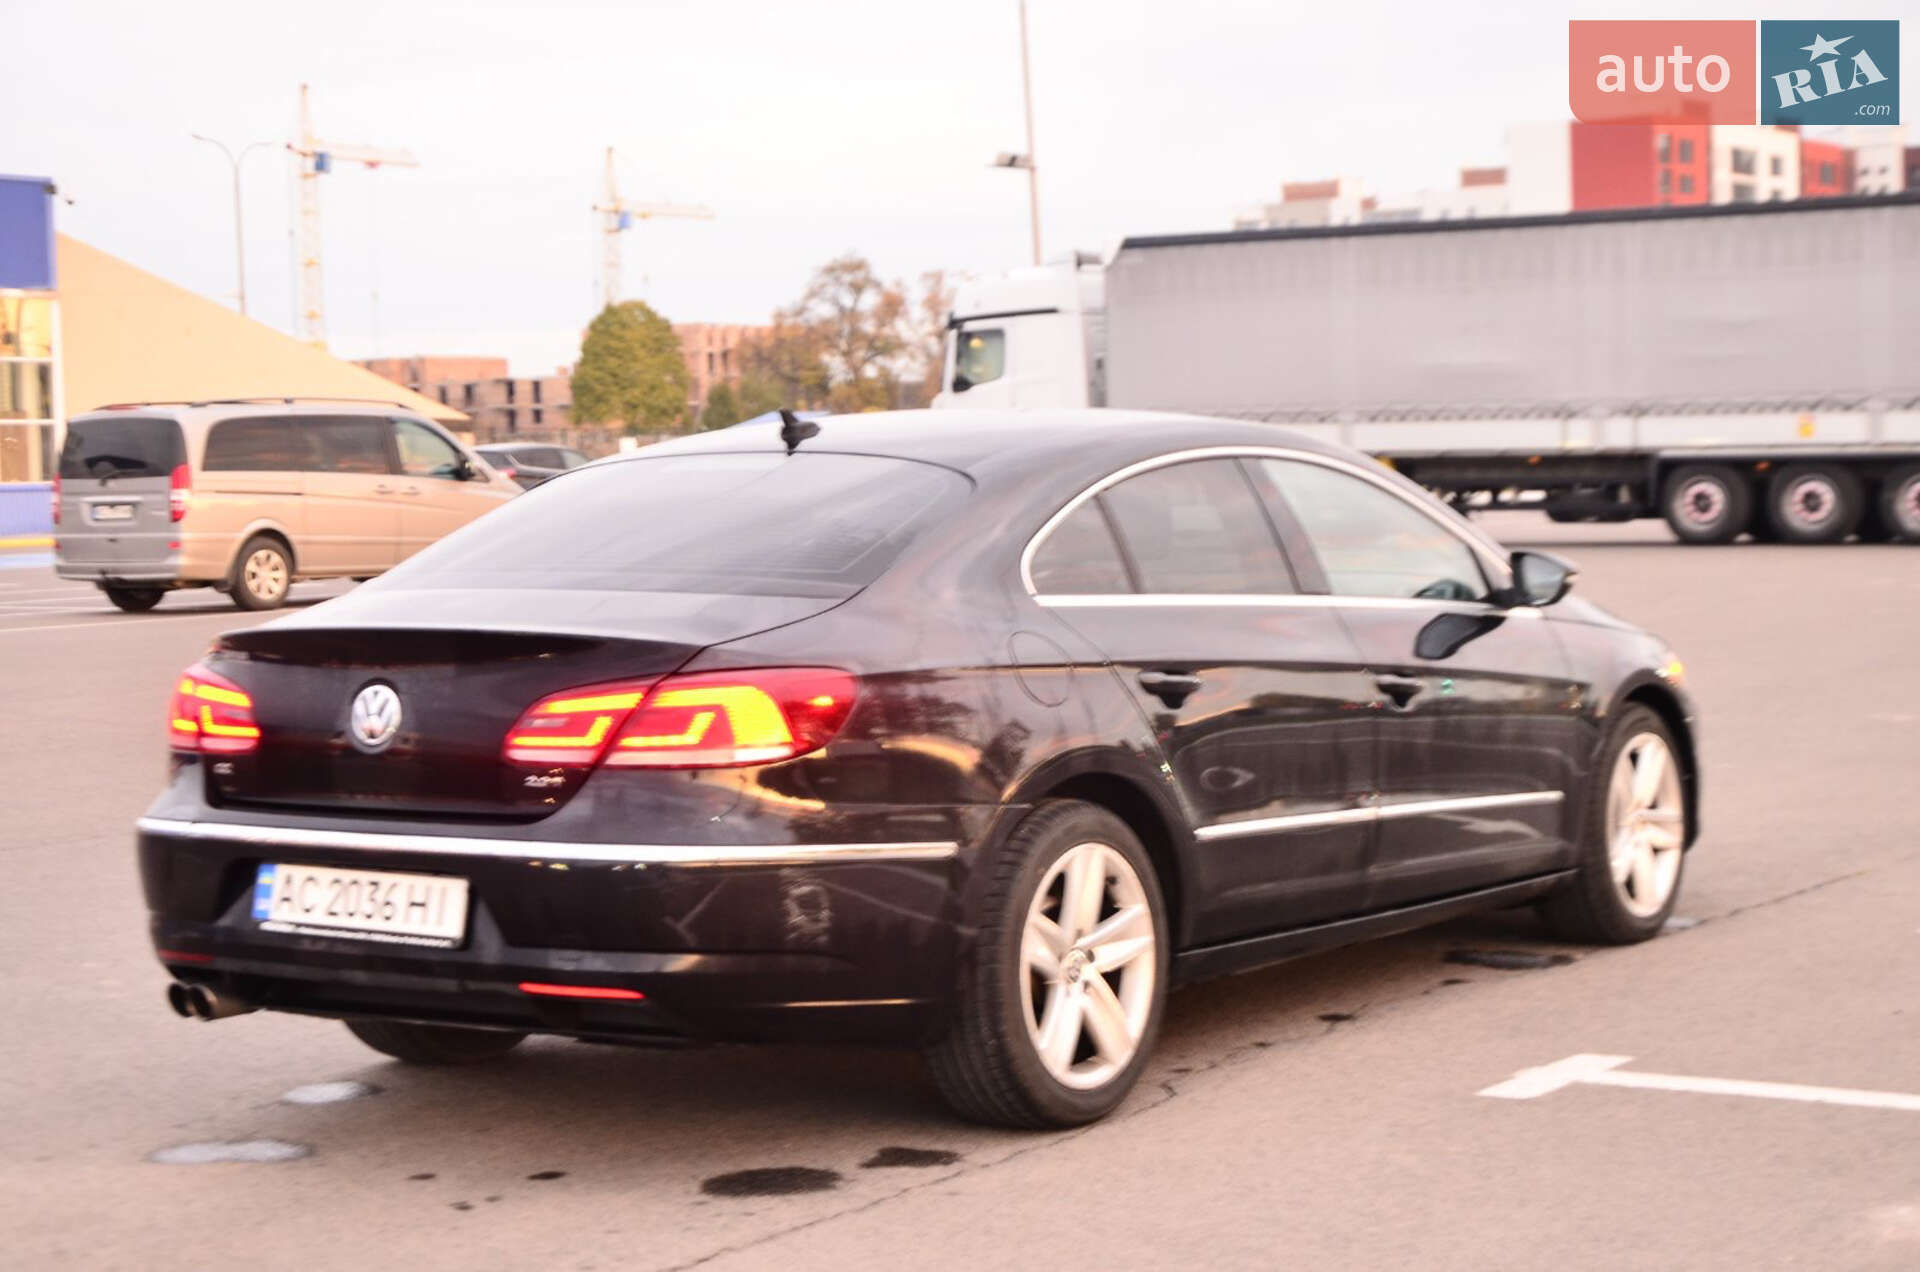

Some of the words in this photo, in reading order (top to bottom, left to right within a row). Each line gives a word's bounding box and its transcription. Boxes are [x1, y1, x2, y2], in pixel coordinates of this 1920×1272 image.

[275, 873, 318, 913] AC
[326, 878, 398, 920] 2036
[404, 884, 447, 926] HI
